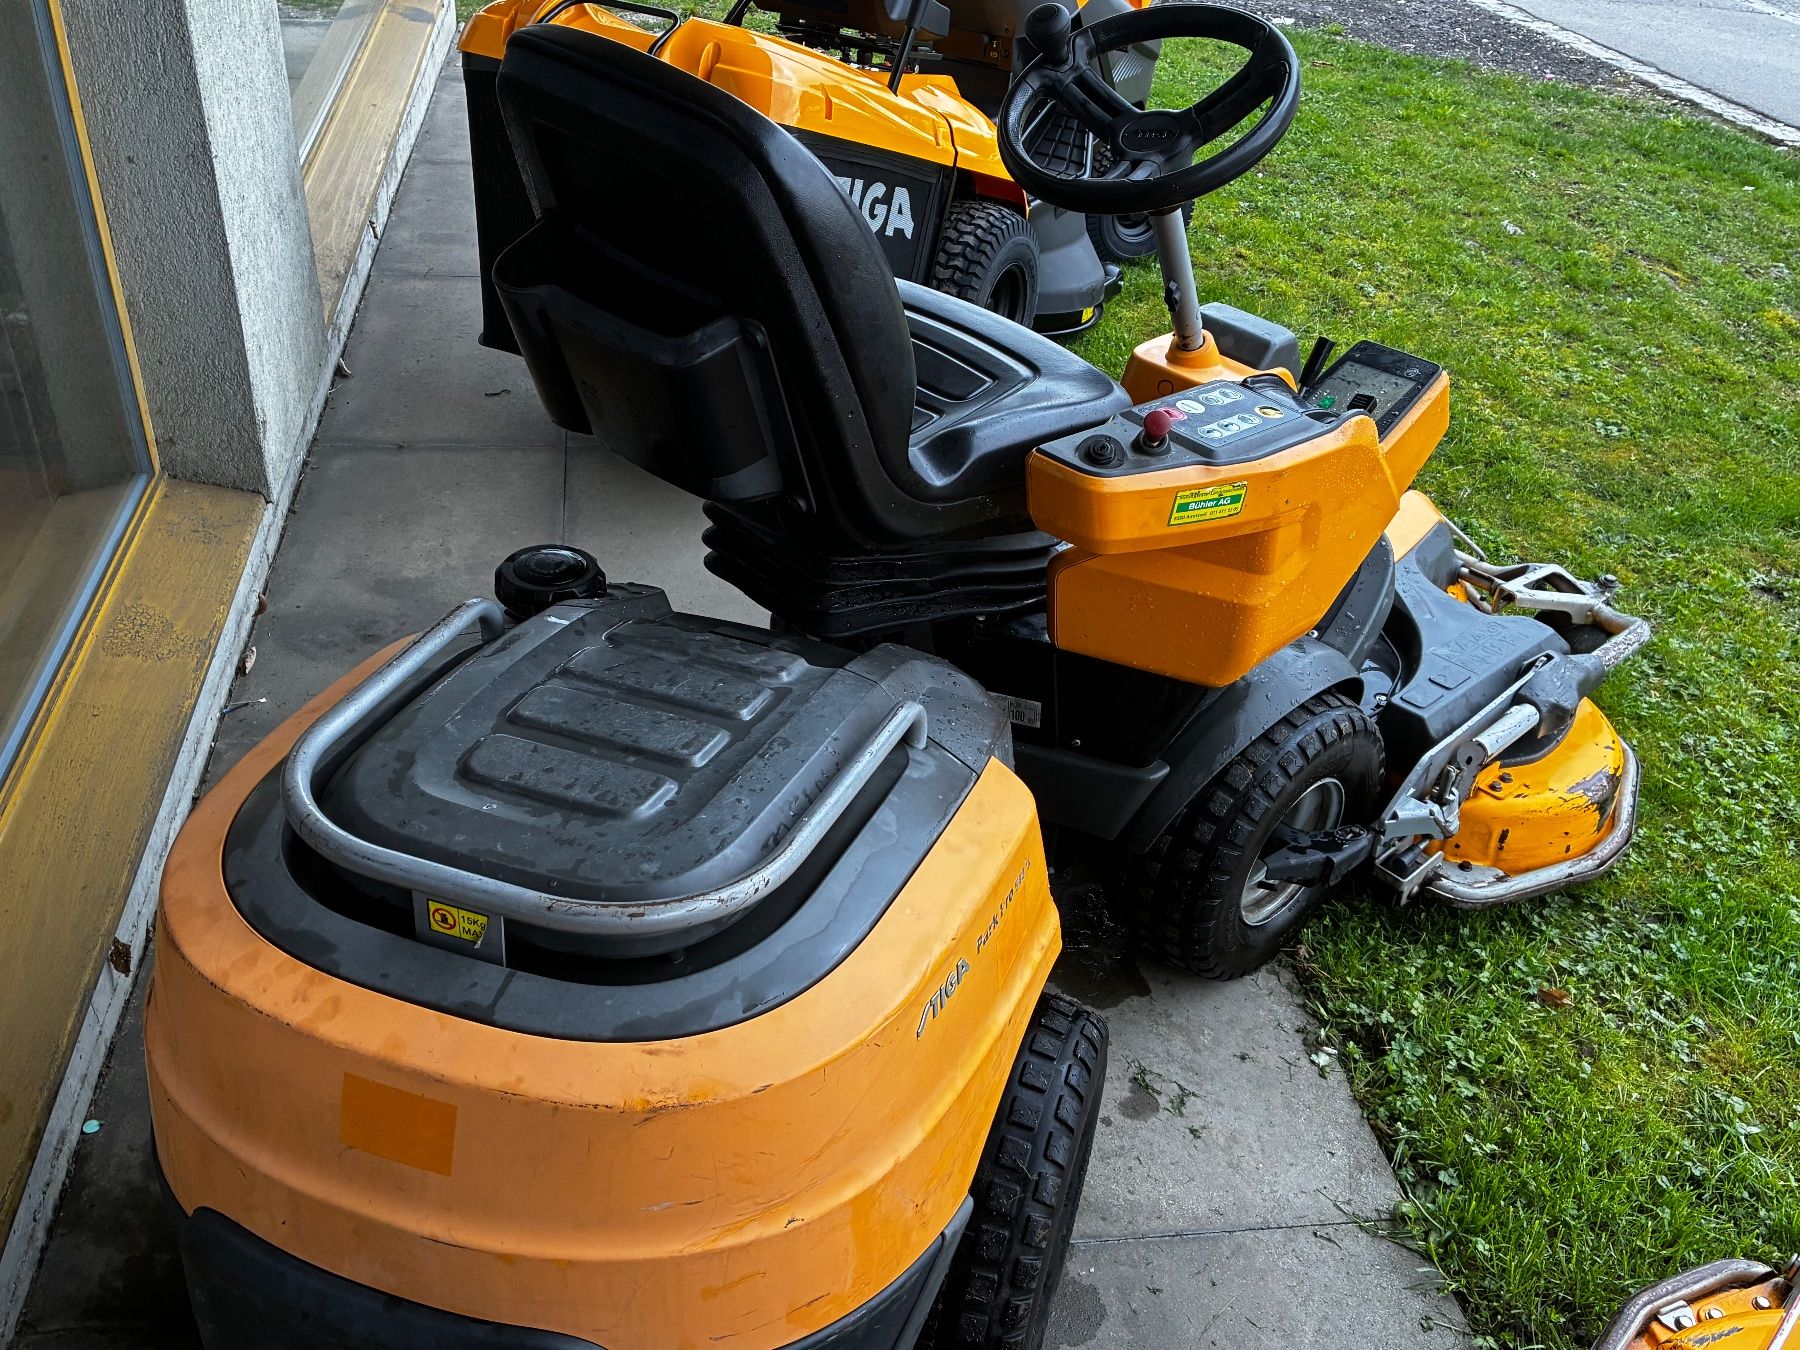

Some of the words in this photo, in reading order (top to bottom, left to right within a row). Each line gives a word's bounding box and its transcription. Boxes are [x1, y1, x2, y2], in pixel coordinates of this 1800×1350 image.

[1217, 497, 1232, 507] AG
[461, 915, 486, 931] 15Kg
[917, 957, 971, 1041] STIGA
